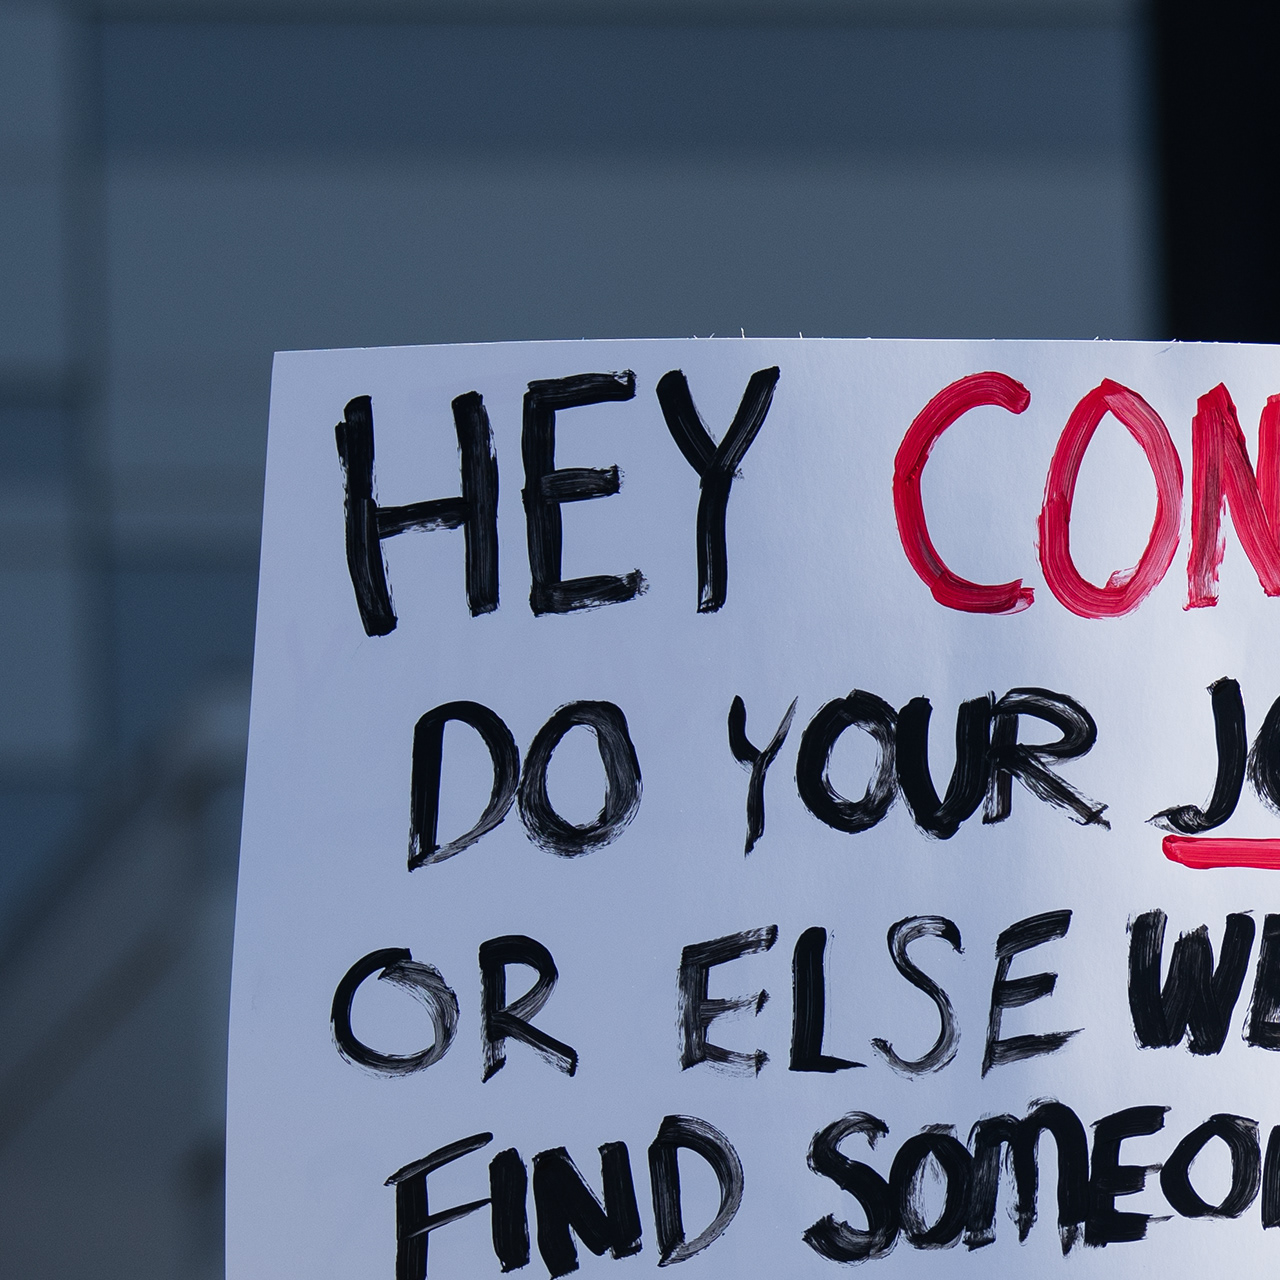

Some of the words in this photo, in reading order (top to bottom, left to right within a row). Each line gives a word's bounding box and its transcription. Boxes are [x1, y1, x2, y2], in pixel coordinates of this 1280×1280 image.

[335, 364, 782, 638] HEY
[407, 699, 645, 872] DO
[727, 687, 1112, 857] YOUR
[329, 934, 580, 1083] OR
[676, 908, 1085, 1080] ELSE
